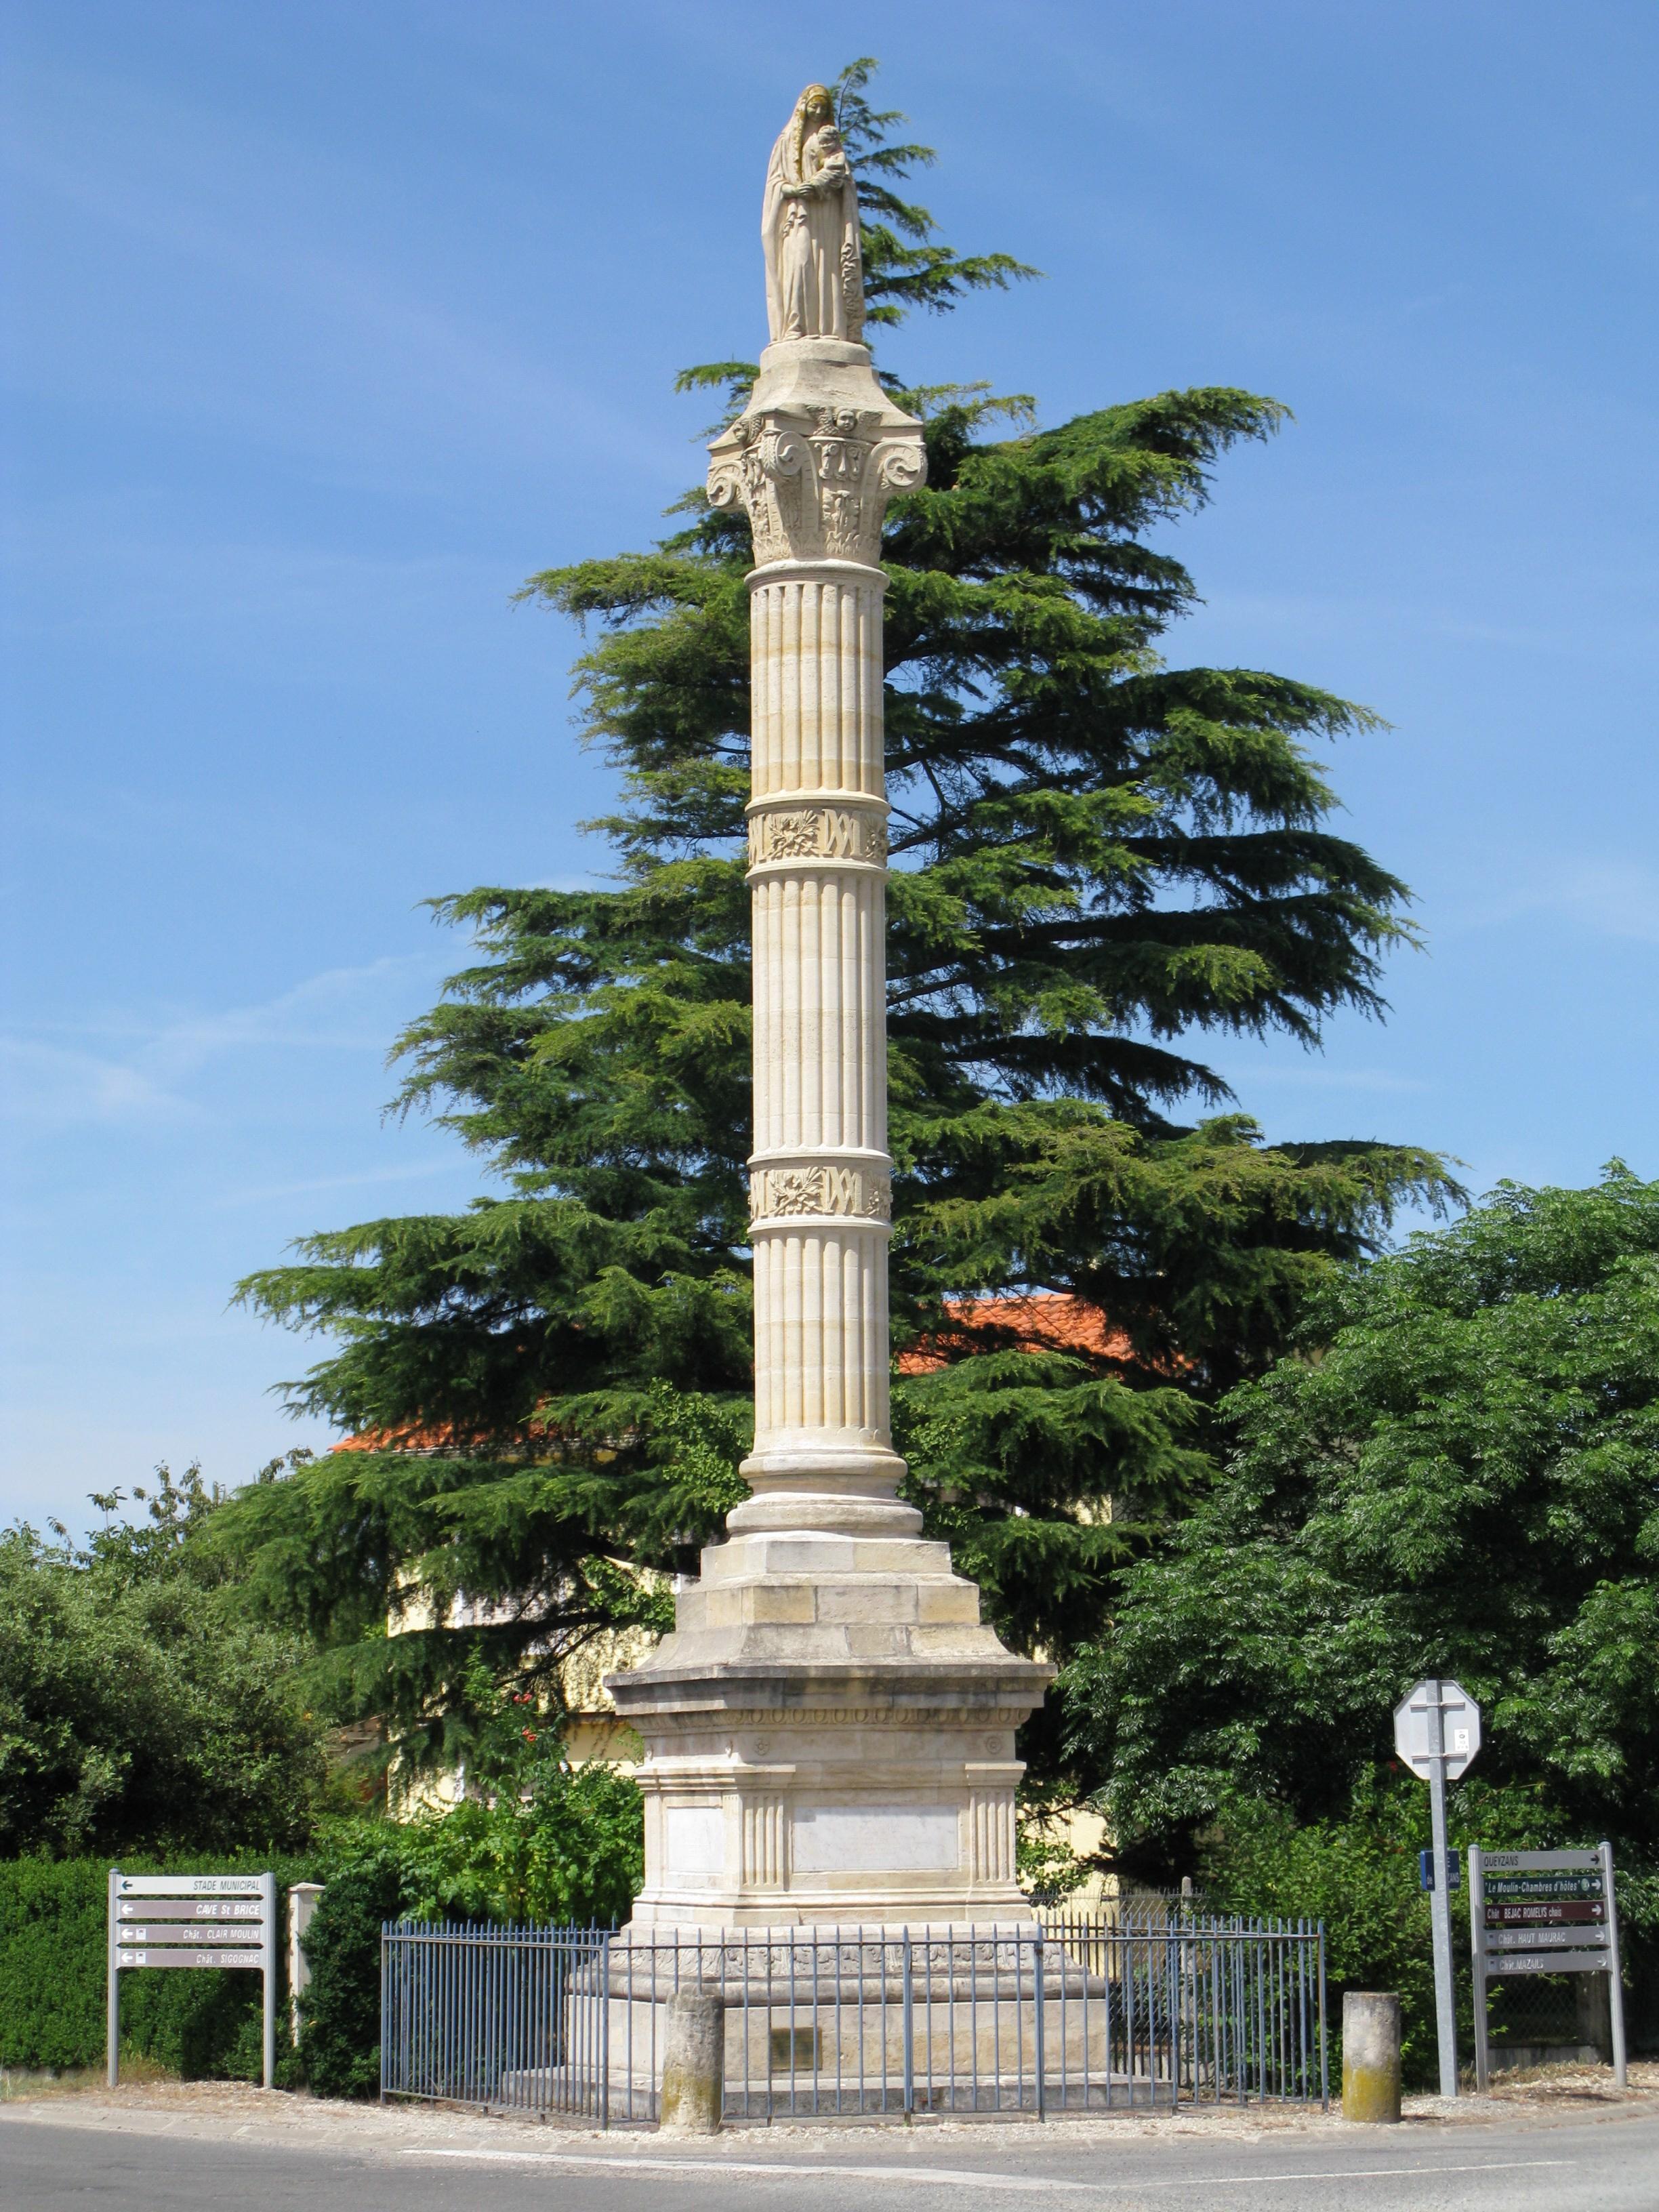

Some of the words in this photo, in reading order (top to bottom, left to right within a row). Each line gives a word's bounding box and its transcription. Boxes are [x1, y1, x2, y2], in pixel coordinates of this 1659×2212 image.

[1484, 1856, 1519, 1867] QUEYZANS
[194, 1881, 217, 1891] STADE
[220, 1881, 260, 1891] MUNICIPAL
[196, 1904, 218, 1915] CAVE
[221, 1904, 230, 1915] St
[233, 1904, 260, 1915] BRICE
[1504, 1906, 1521, 1919] BEJAC
[1522, 1906, 1548, 1919] ROMELYS
[207, 1929, 228, 1939] CLAIR
[230, 1929, 259, 1939] MOULIN
[1518, 1931, 1536, 1944] HAUT
[1538, 1931, 1566, 1943] MAURAC
[220, 1953, 260, 1964] SIGOGNAC
